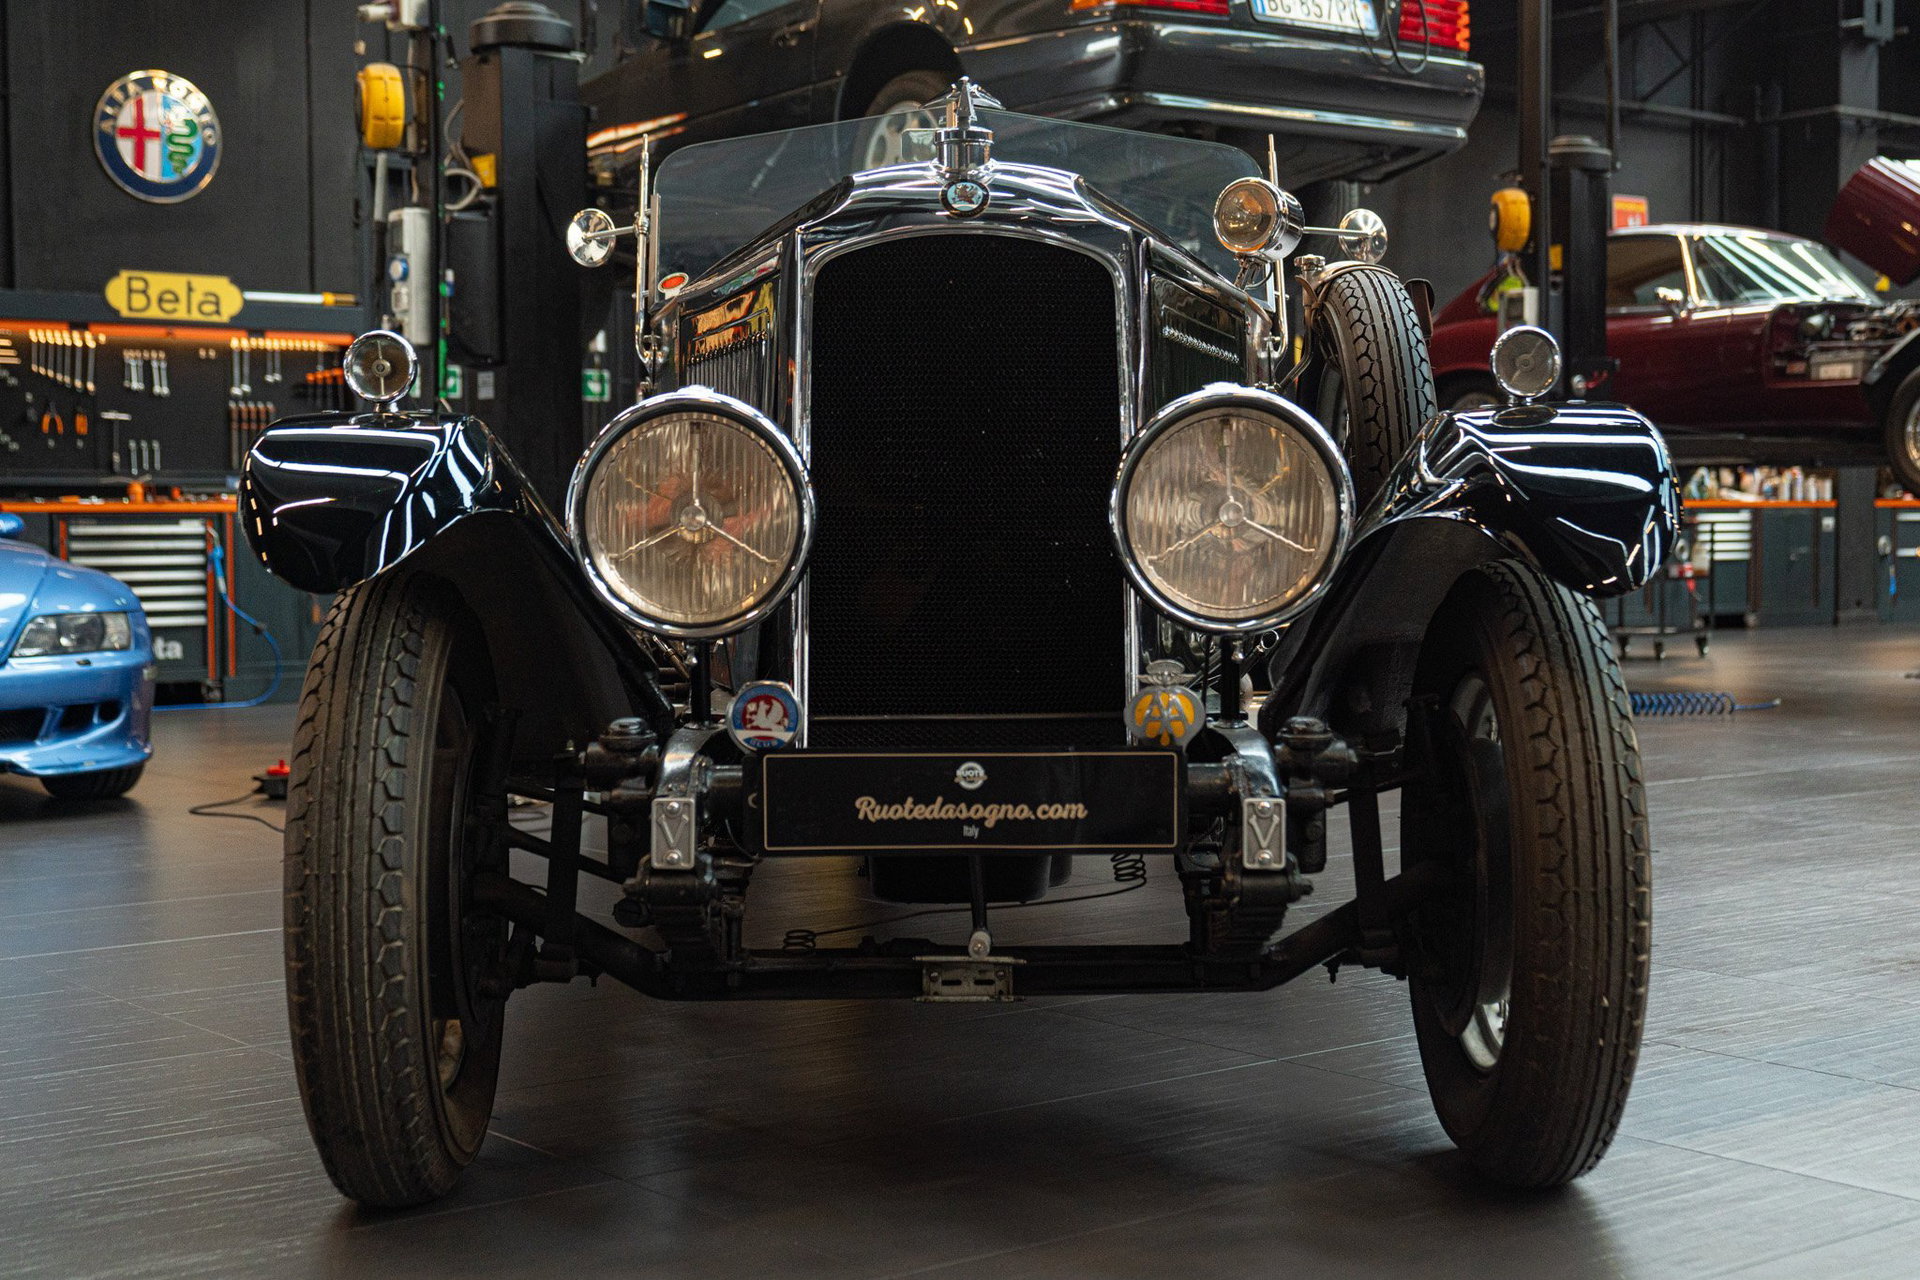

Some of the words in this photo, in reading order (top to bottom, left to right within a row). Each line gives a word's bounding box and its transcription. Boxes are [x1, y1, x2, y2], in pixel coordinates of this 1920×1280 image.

[126, 275, 221, 317] Beta
[153, 635, 184, 660] ta
[854, 795, 1088, 829] Ruotedasogno.com
[962, 824, 980, 839] Italy
